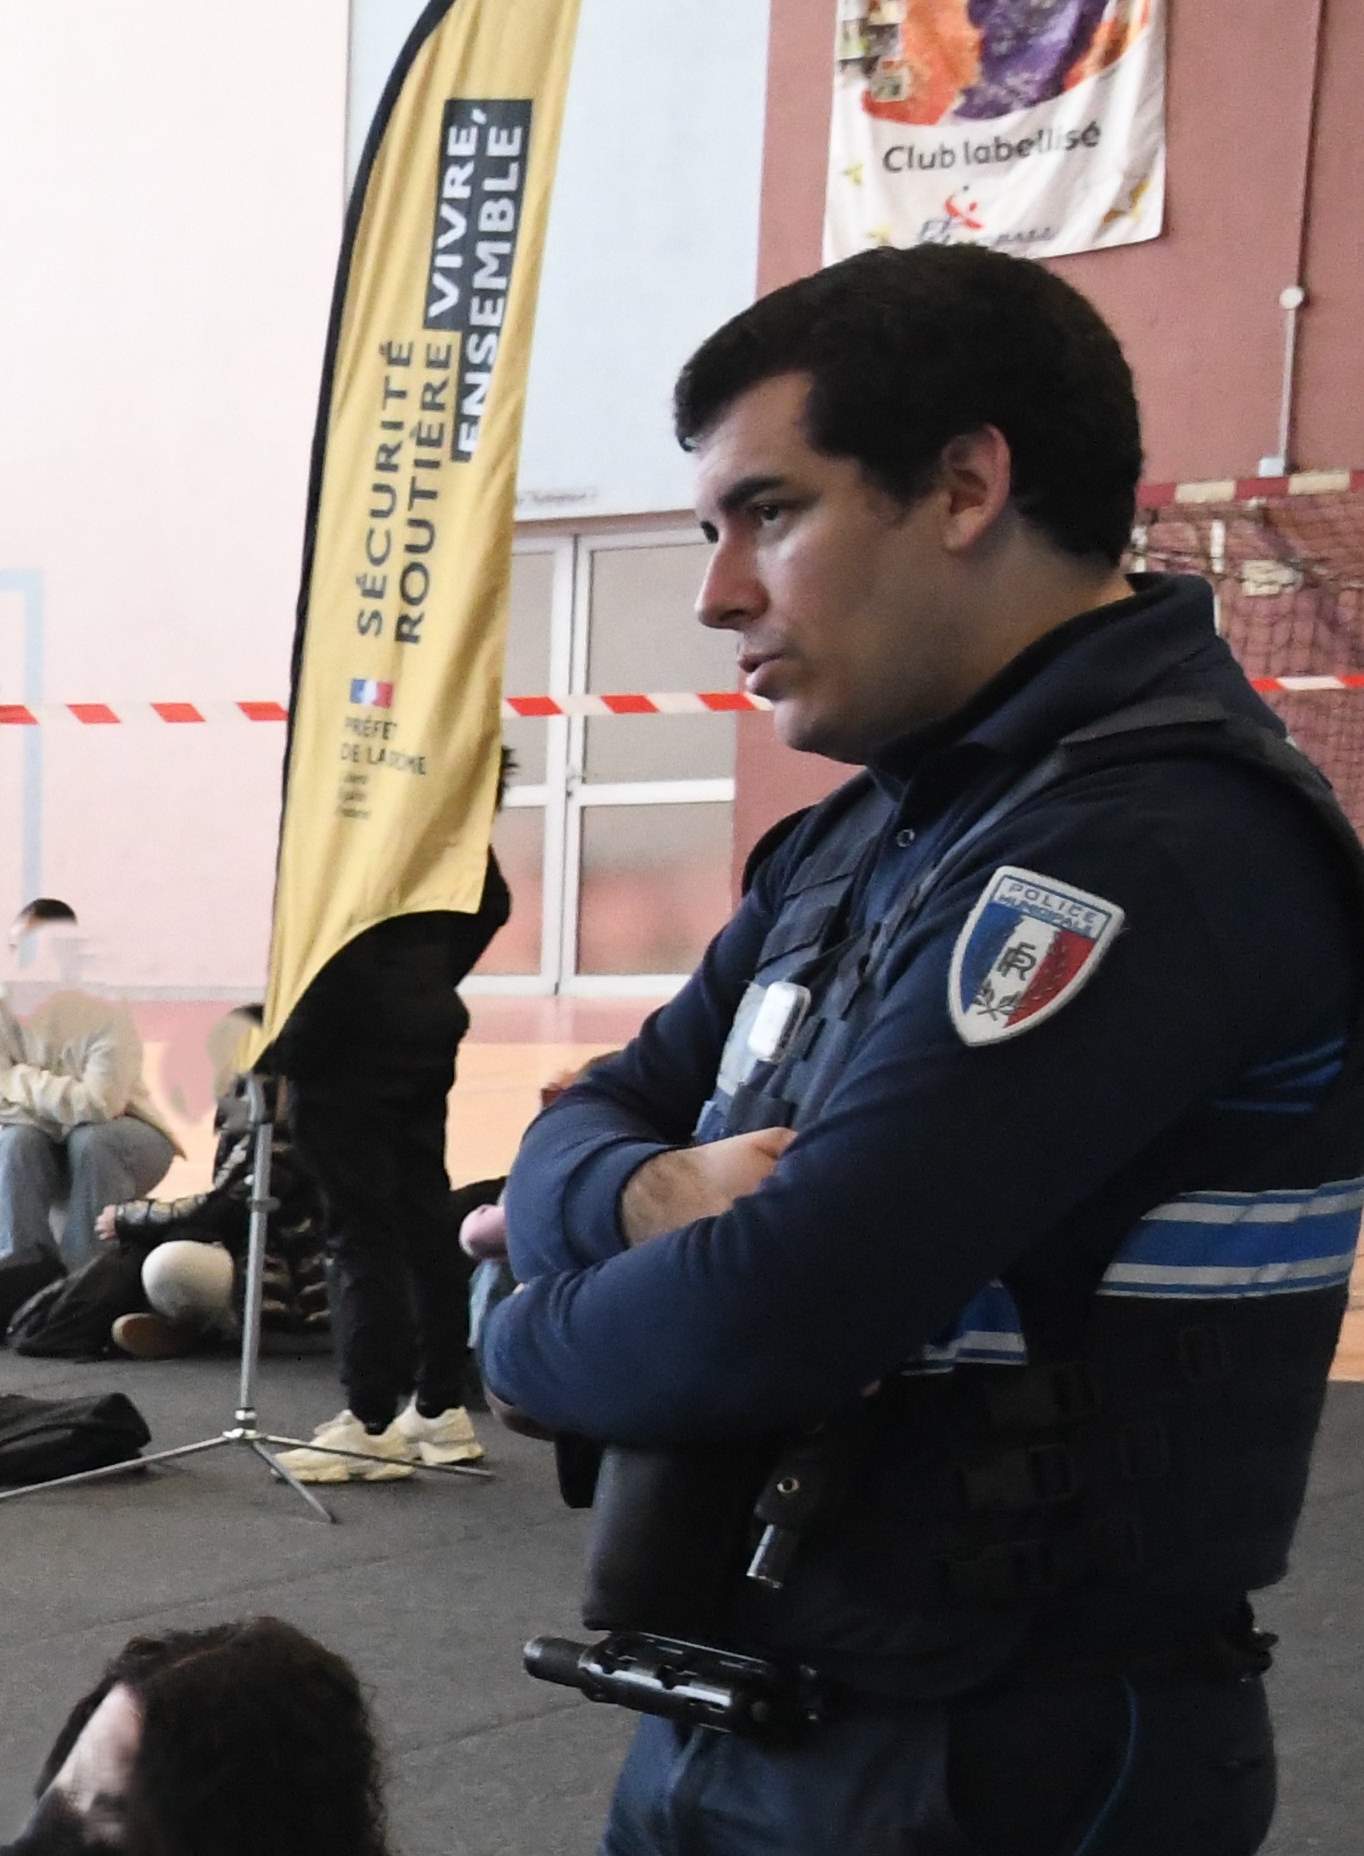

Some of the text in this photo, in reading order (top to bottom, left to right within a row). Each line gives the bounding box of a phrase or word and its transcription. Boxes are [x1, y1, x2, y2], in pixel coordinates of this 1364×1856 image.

[458, 125, 522, 452] ENSEMBLE
[883, 120, 1101, 172] Club labellisé
[356, 340, 414, 637] SÉCURITÉ
[394, 341, 452, 644] ROUTIÈRE
[1009, 883, 1099, 924] POLICE
